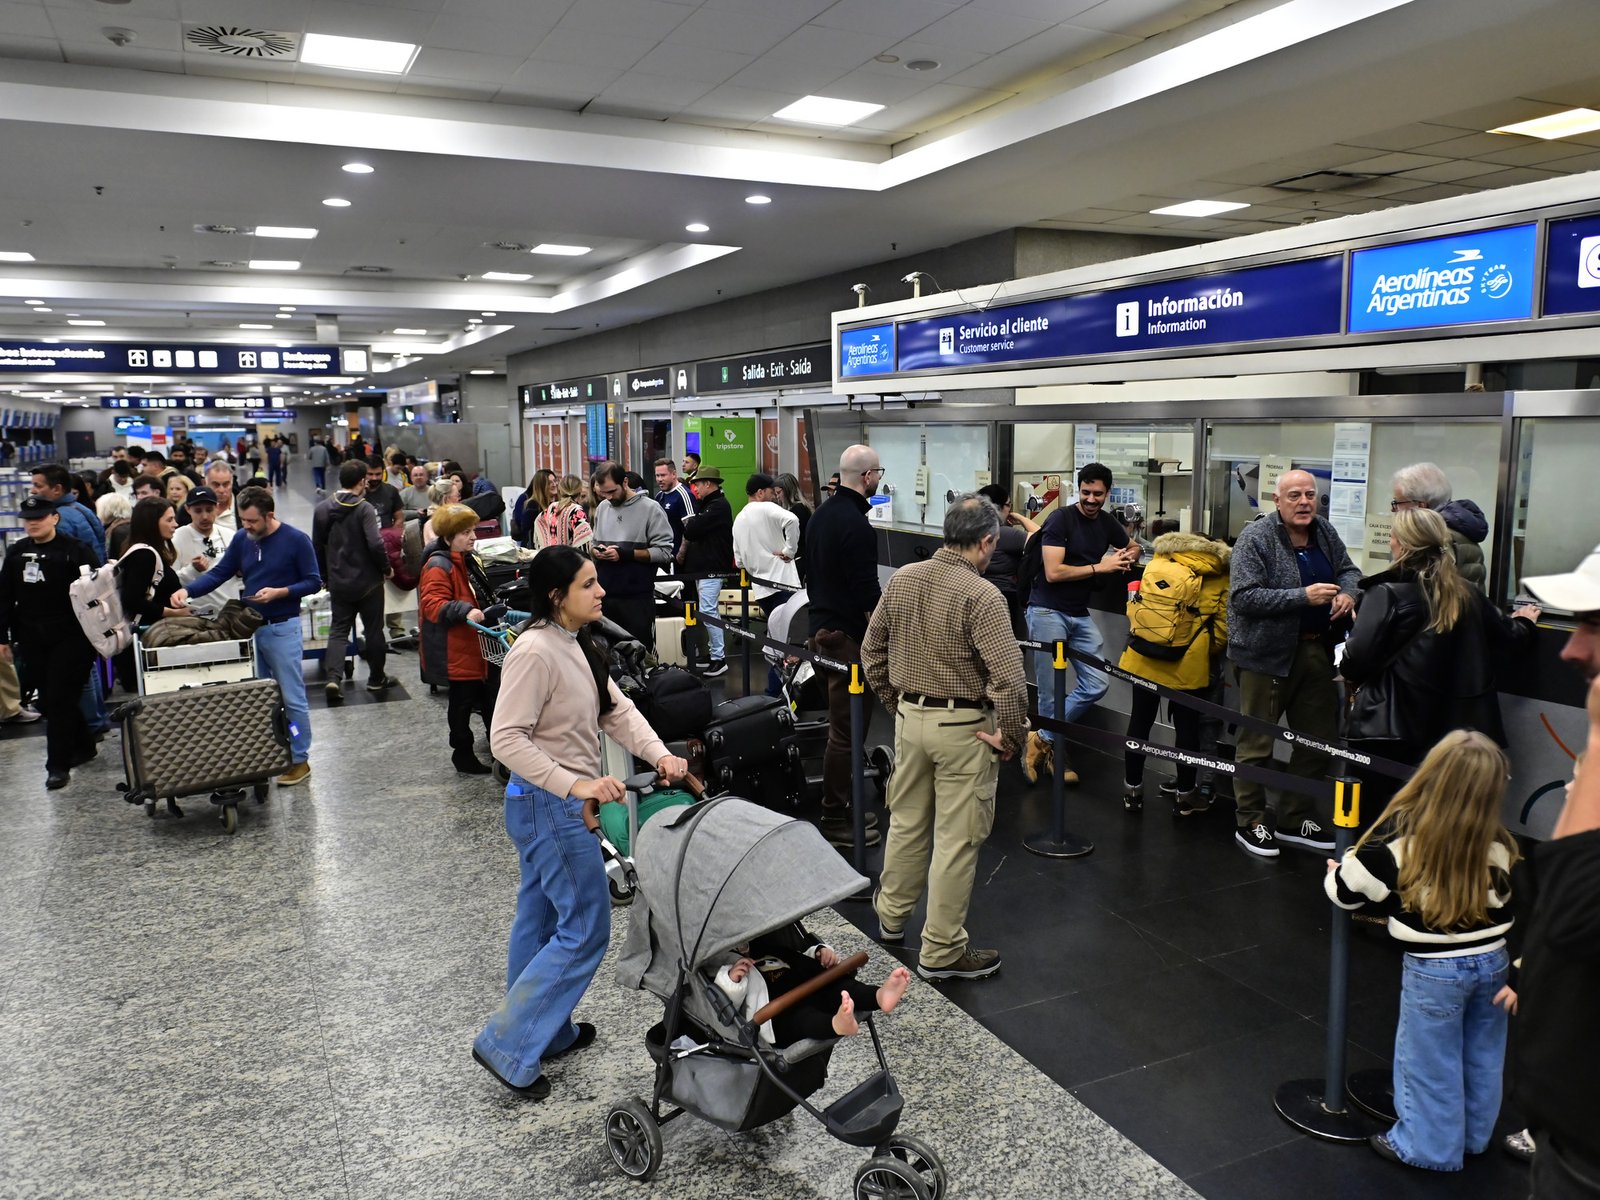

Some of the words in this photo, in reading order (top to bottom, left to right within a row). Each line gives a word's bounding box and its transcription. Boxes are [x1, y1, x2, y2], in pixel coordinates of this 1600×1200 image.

[1371, 266, 1475, 294] Aerolíneas
[1148, 288, 1243, 317] Información
[1366, 286, 1472, 316] Argentinas
[959, 321, 998, 340] Servicio
[1000, 319, 1010, 335] al
[1011, 316, 1049, 334] cliente
[1147, 318, 1207, 335] Information
[848, 342, 879, 356] Aerolíneas
[959, 343, 990, 354] Customer
[990, 339, 1015, 352] service
[742, 363, 766, 380] Salida
[770, 361, 785, 377] Exit
[790, 357, 812, 376] Saída
[846, 354, 878, 368] Argentinas
[716, 443, 744, 452] tripstore
[1141, 743, 1179, 759] Aeropuertos
[1178, 752, 1216, 768] Argentina
[1215, 761, 1236, 773] 2000
[1295, 734, 1325, 750] Aeropuertos
[1324, 743, 1355, 760] Argentina
[1354, 753, 1371, 765] 2000
